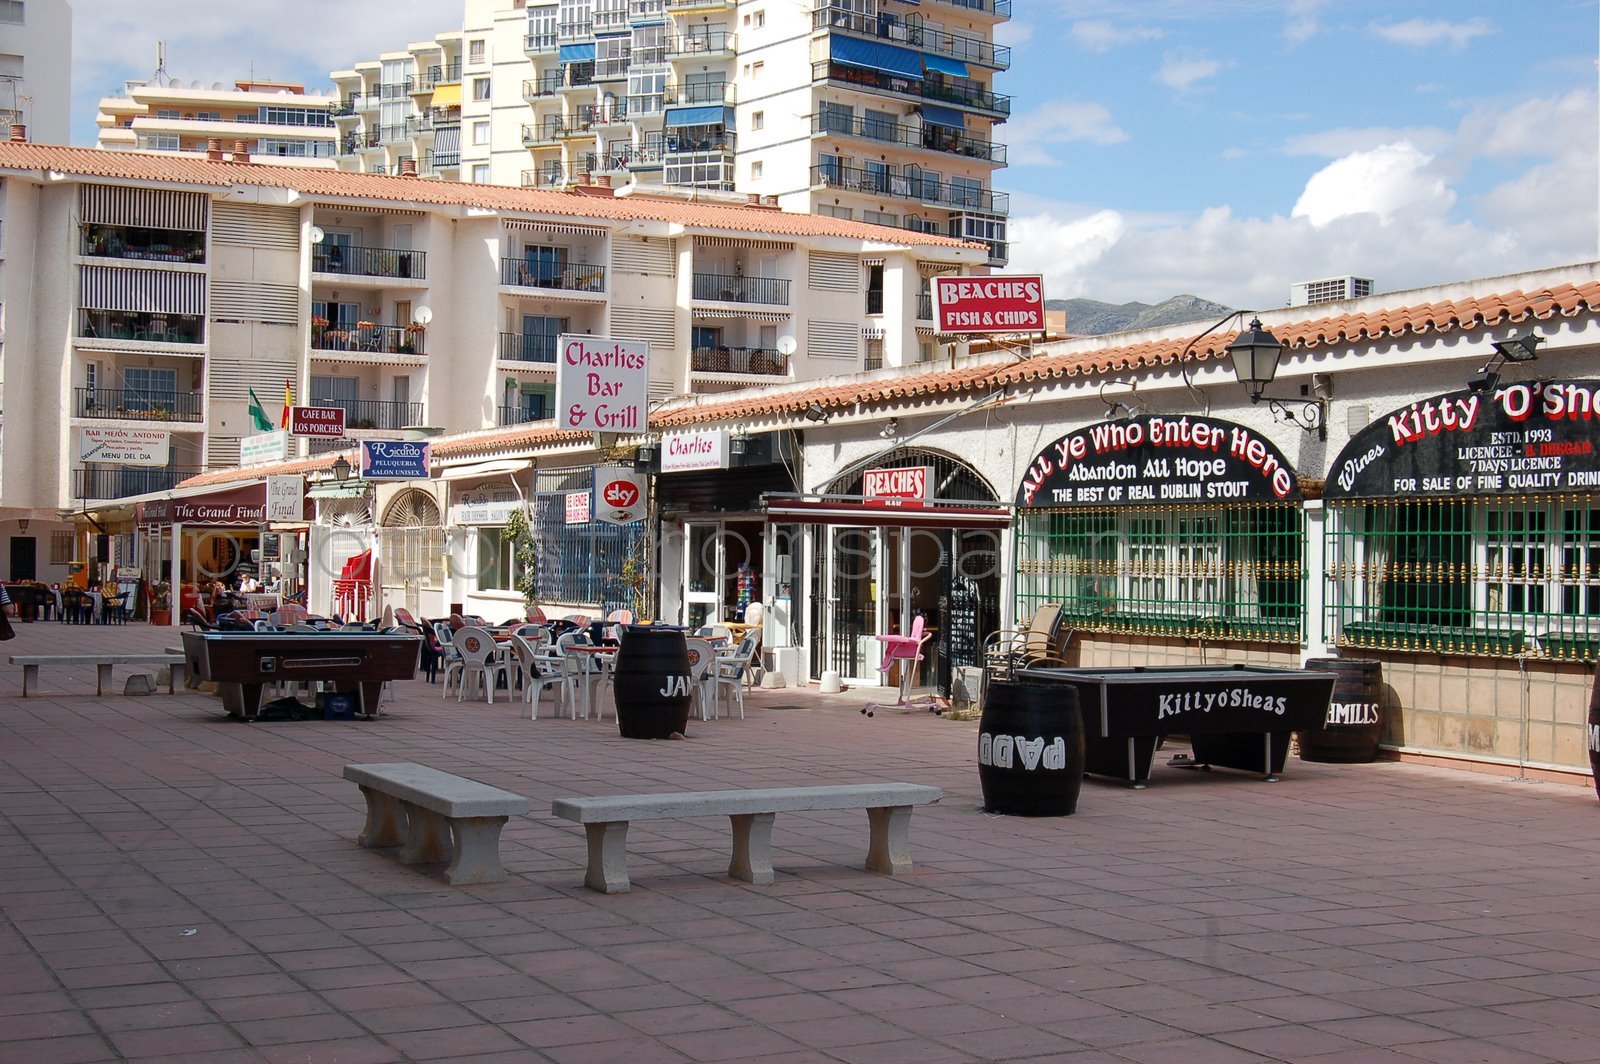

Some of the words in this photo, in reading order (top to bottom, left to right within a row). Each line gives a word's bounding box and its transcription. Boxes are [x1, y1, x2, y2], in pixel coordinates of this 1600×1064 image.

[941, 282, 1040, 305] BEACHES
[946, 312, 980, 326] FISH
[982, 311, 994, 326] &
[995, 311, 1038, 325] CHIPS
[565, 342, 645, 370] Charlies
[586, 372, 623, 397] Bar
[301, 409, 320, 419] CAFE
[321, 410, 336, 420] BAR
[569, 403, 588, 427] &
[594, 404, 637, 429] Grill
[1388, 395, 1481, 446] Kitty
[132, 432, 165, 440] ANTONIO
[294, 423, 308, 432] LOS
[309, 424, 343, 434] PORCHES
[1491, 431, 1522, 446] ESTD.
[1524, 428, 1552, 444] 1993
[371, 442, 421, 458] Ricardo
[669, 435, 713, 456] Charlies
[1458, 446, 1513, 460] LICENCEE
[375, 460, 417, 468] PELUQUERIA
[1089, 423, 1145, 454] Who
[1149, 416, 1226, 452] Enter
[1230, 427, 1292, 499] Here
[1511, 457, 1561, 471] LICENCE
[1068, 460, 1137, 481] Abandon
[1143, 458, 1171, 478] All
[1175, 457, 1226, 481] Hope
[1338, 444, 1386, 492] Wines
[1052, 488, 1072, 503] THE
[1077, 486, 1104, 502] BEST
[1108, 485, 1123, 501] OF
[1128, 484, 1156, 500] REAL
[1160, 482, 1202, 499] DUBLIN
[1206, 481, 1249, 498] STOUT
[1394, 478, 1417, 492] FOR
[1422, 477, 1451, 491] SALE
[1456, 476, 1472, 490] OF
[1477, 475, 1502, 489] FINE
[1508, 472, 1561, 489] QUALITY
[607, 484, 635, 506] sky
[175, 504, 195, 517] The
[197, 504, 234, 518] Grand
[236, 504, 266, 518] Final
